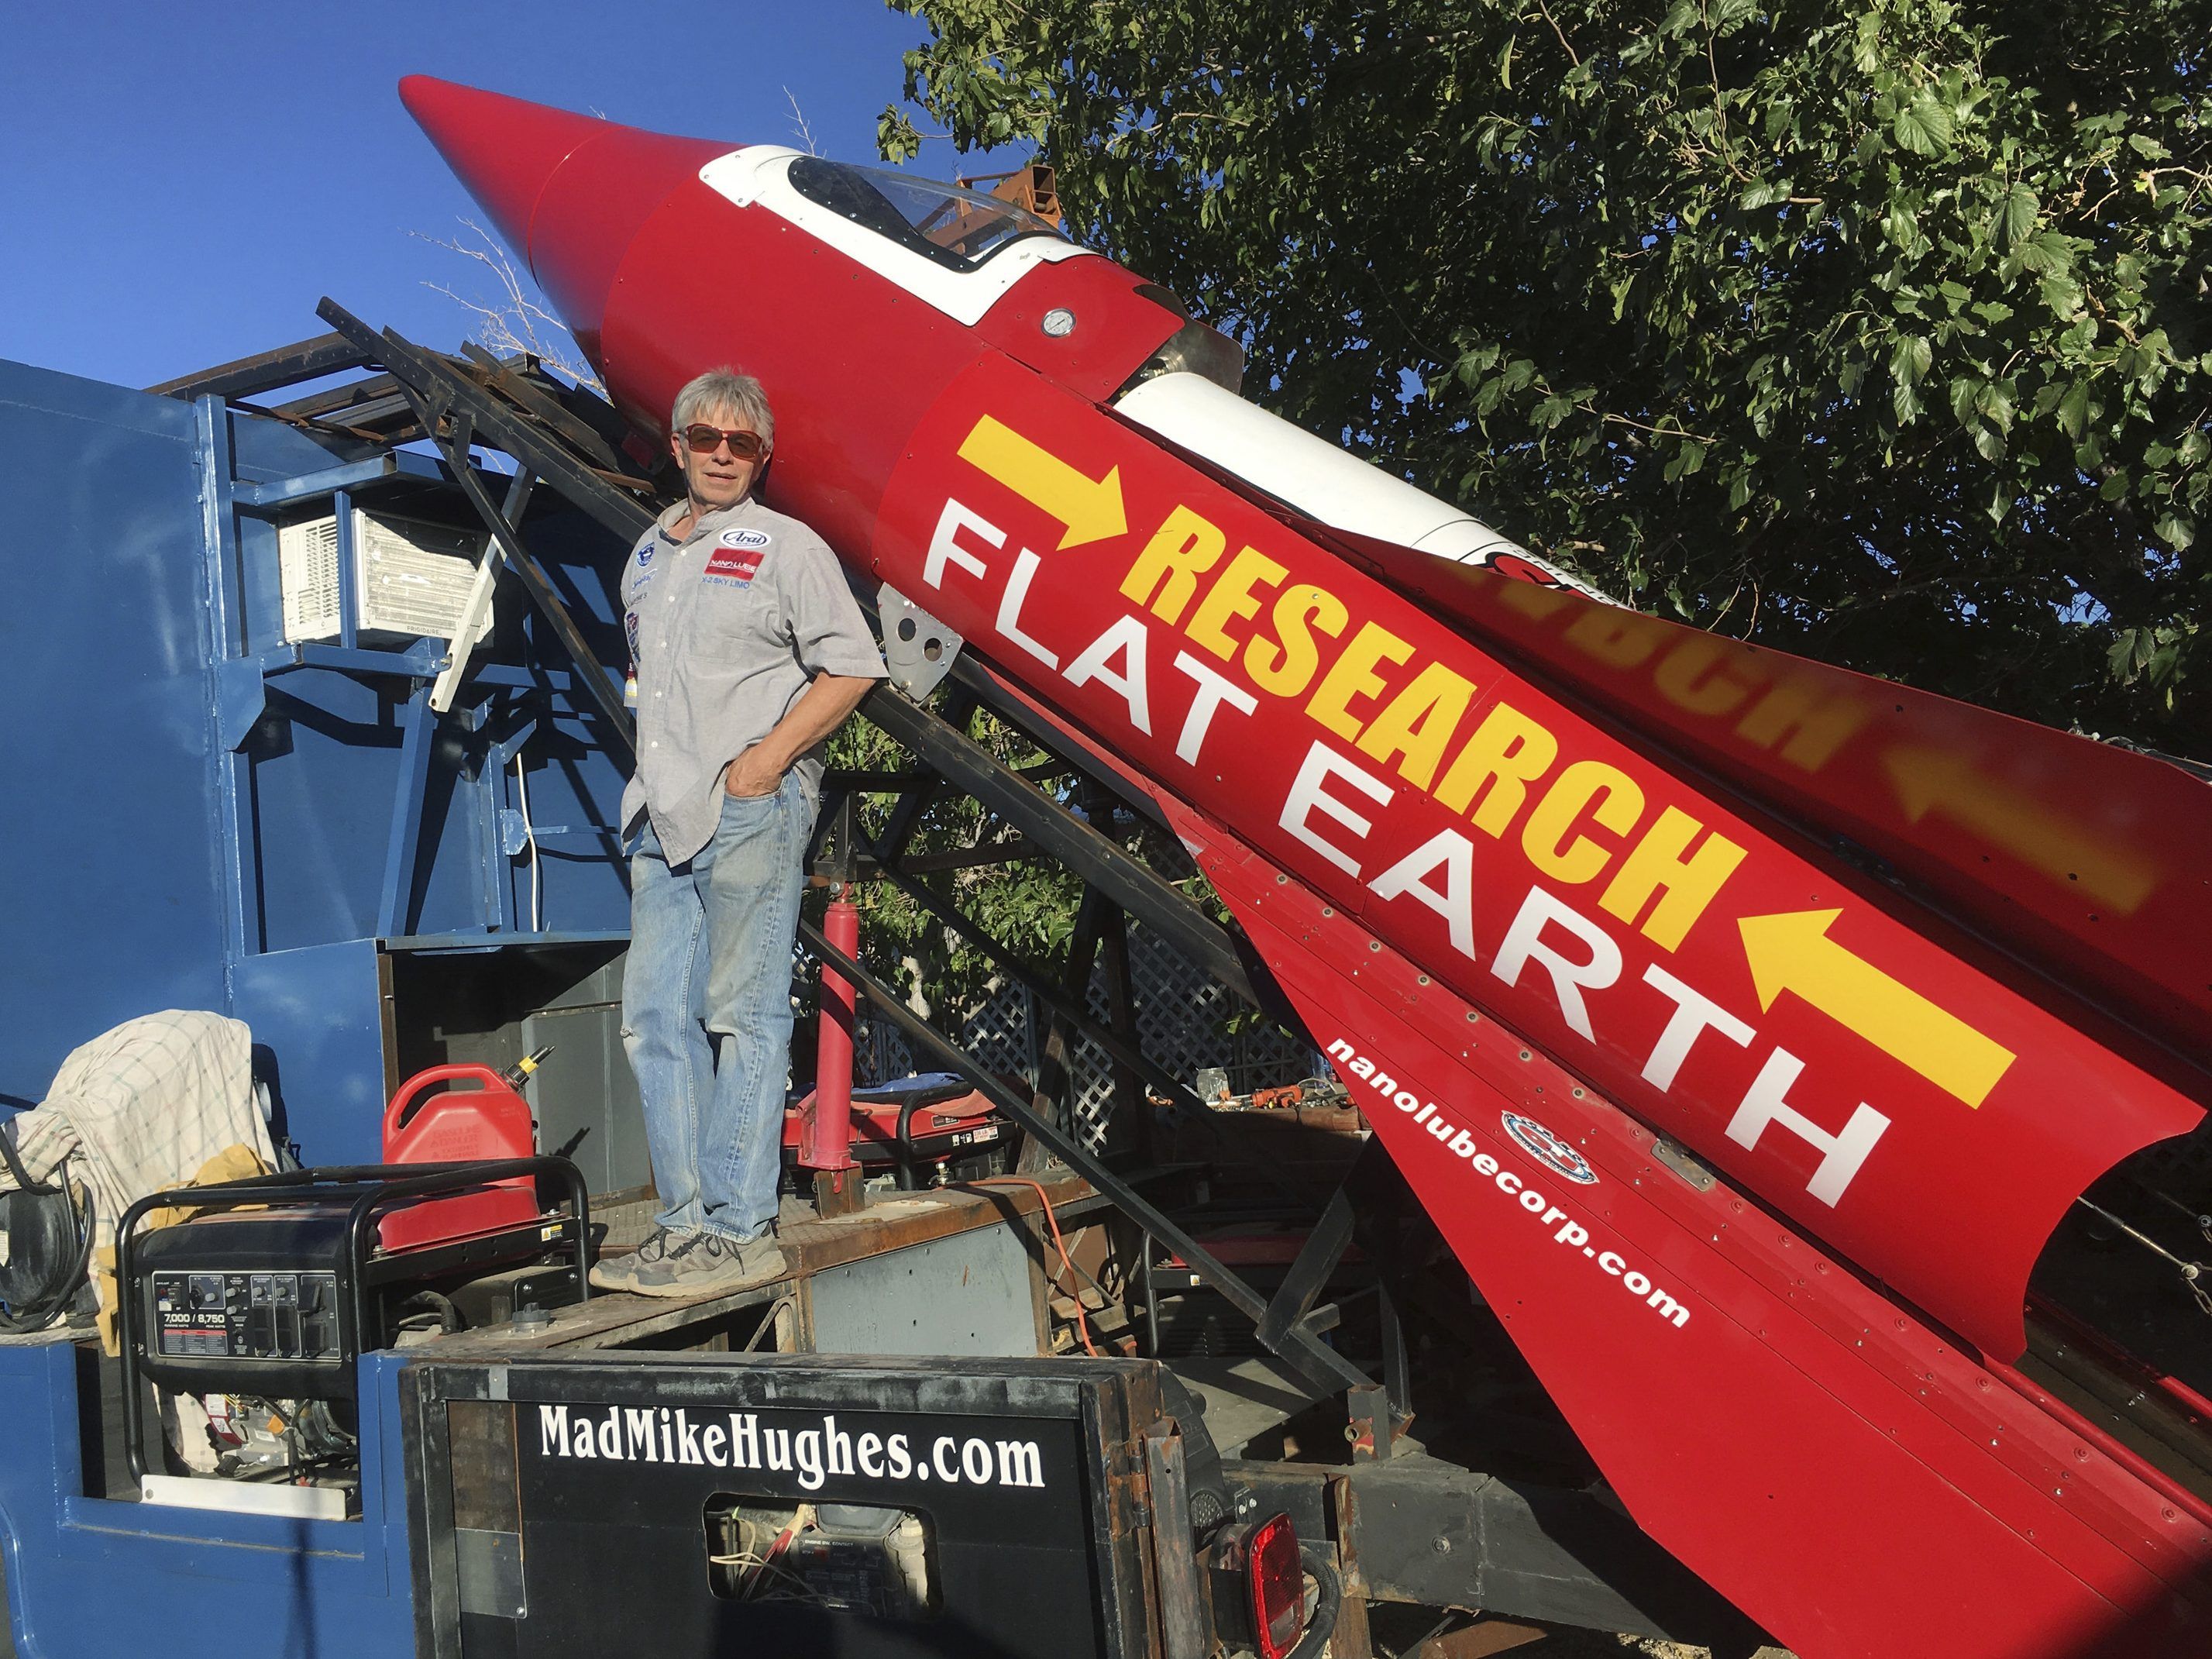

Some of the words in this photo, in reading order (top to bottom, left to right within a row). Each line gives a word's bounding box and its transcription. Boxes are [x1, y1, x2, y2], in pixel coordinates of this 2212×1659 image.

[730, 580, 750, 589] LIMO
[407, 625, 439, 635] FRIGIDAIRE
[1120, 505, 1747, 952] RESEARCH
[922, 497, 1259, 766] FLAT
[1278, 739, 1891, 1209] EARTH
[1326, 1038, 1691, 1328] nanolubecorp.com
[164, 1313, 191, 1323] 7,000
[198, 1314, 225, 1324] 8,750
[538, 1405, 1046, 1491] MadMikeHughes.com
